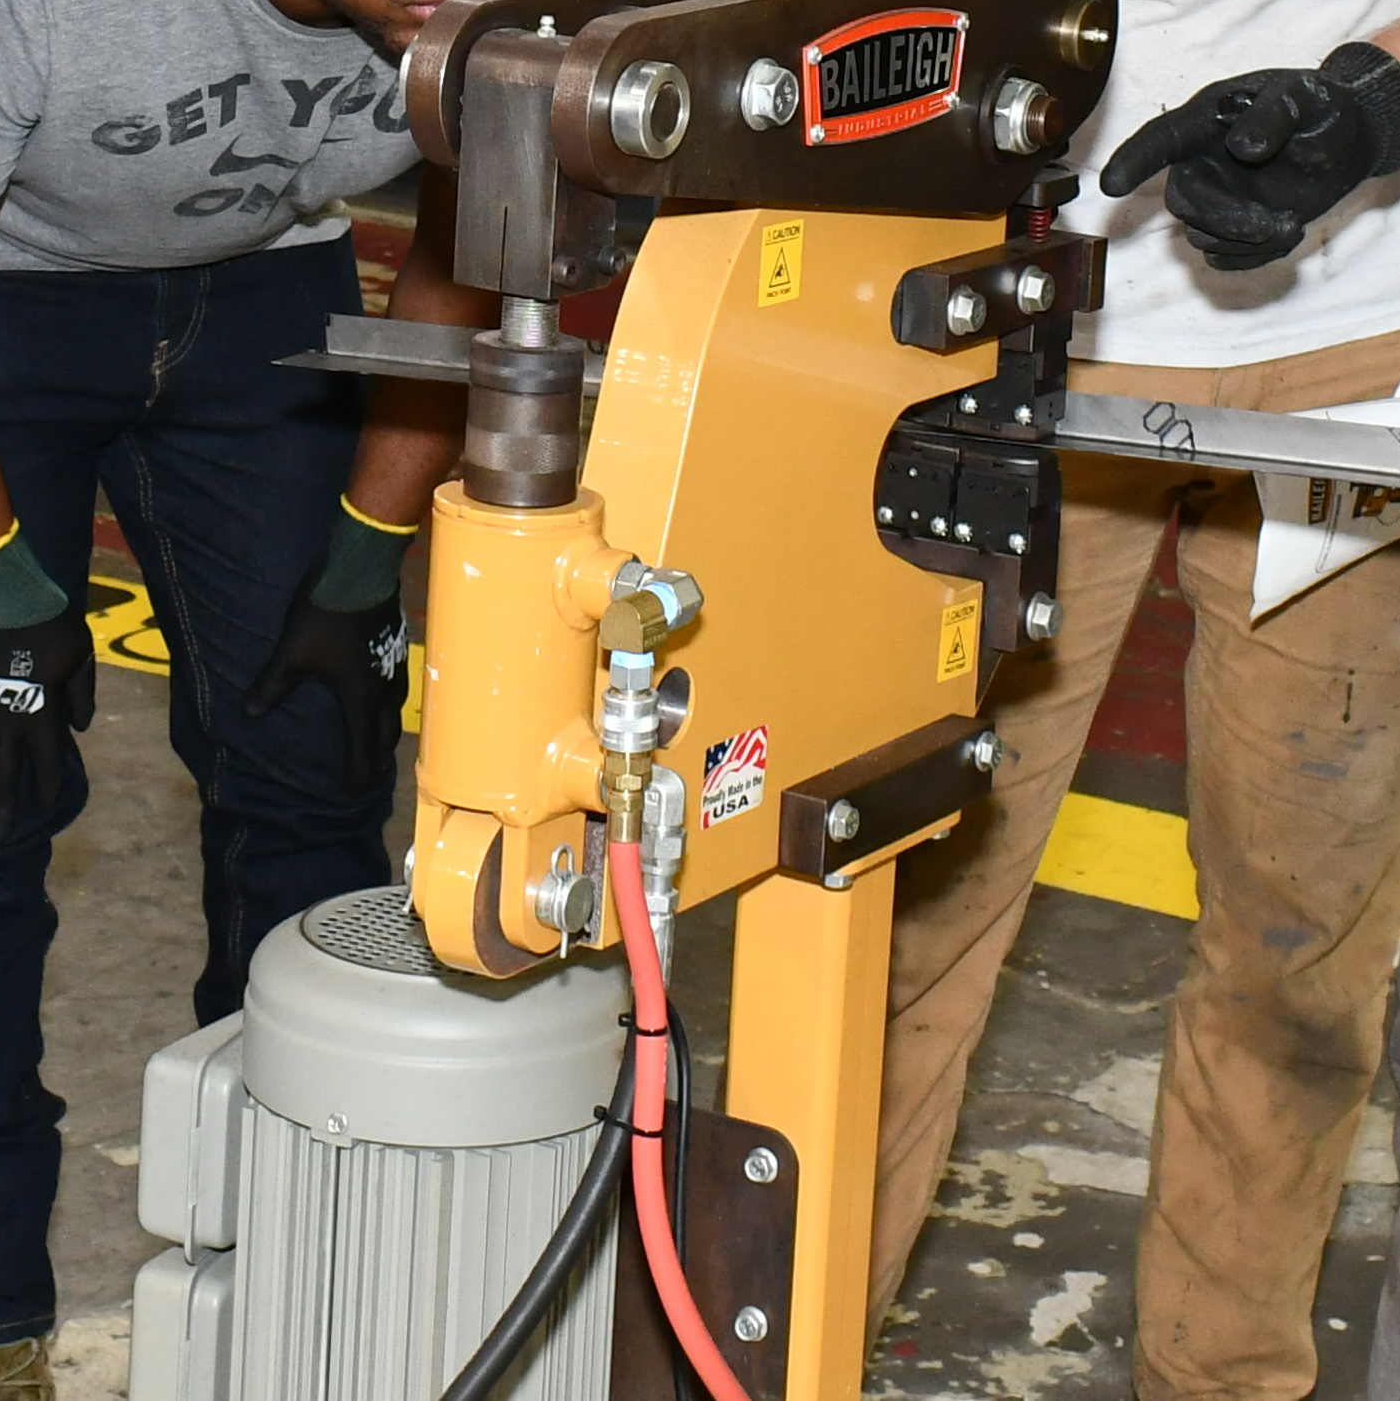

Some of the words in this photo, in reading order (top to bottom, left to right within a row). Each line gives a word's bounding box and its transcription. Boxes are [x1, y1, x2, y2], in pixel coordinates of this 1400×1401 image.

[821, 31, 955, 111] BAILEIGH
[92, 73, 250, 156] GET
[837, 103, 928, 136] INDUSTRIAL
[772, 225, 801, 240] CAUTION
[728, 782, 744, 796] Made
[745, 779, 751, 789] in
[753, 775, 763, 786] the
[713, 794, 749, 819] USA
